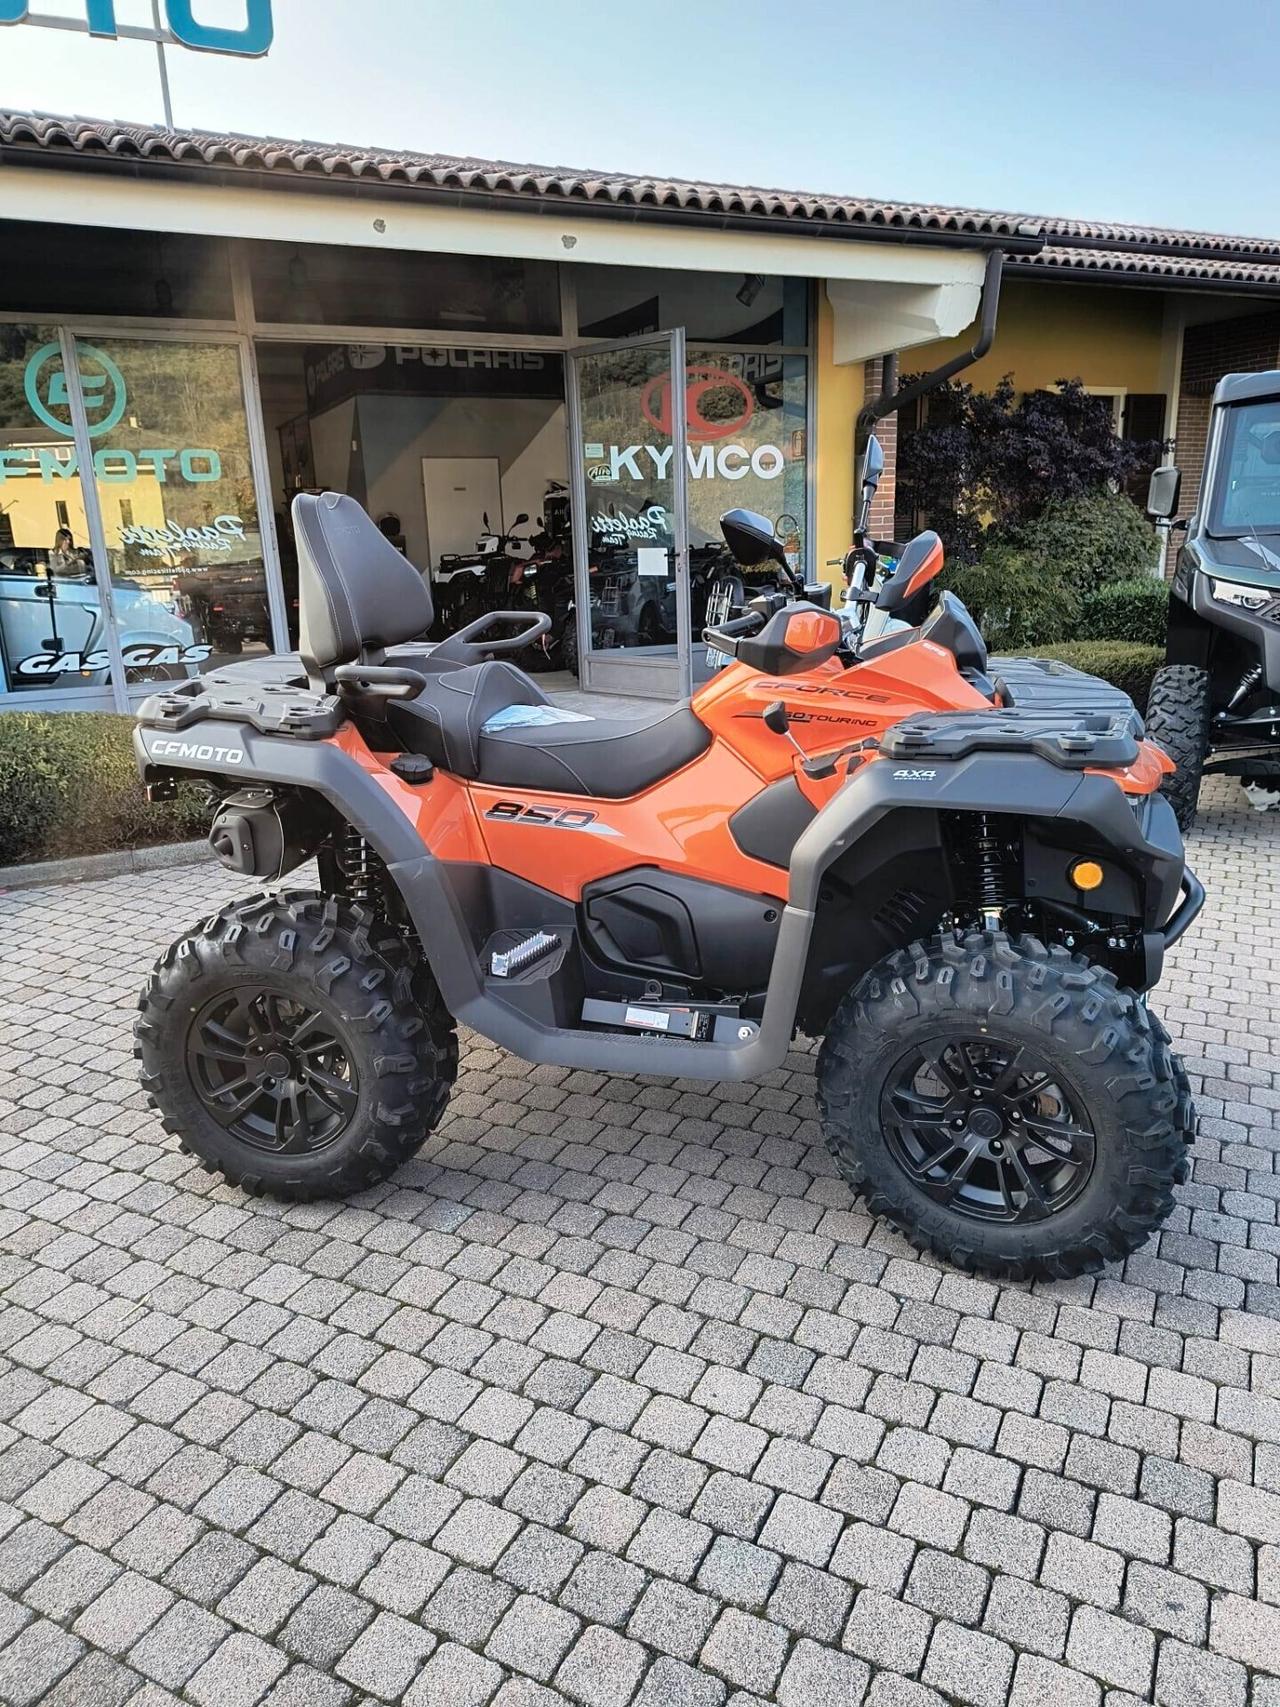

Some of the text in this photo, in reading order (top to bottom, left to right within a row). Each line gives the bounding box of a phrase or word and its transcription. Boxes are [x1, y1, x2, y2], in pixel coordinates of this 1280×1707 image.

[395, 345, 544, 370] POLARIS
[0, 448, 222, 485] FMOTO
[609, 444, 784, 480] KYMCO
[18, 644, 214, 675] GASGAS
[752, 681, 893, 704] CFORCE
[151, 740, 244, 764] CFMOTO
[485, 800, 598, 829] 850
